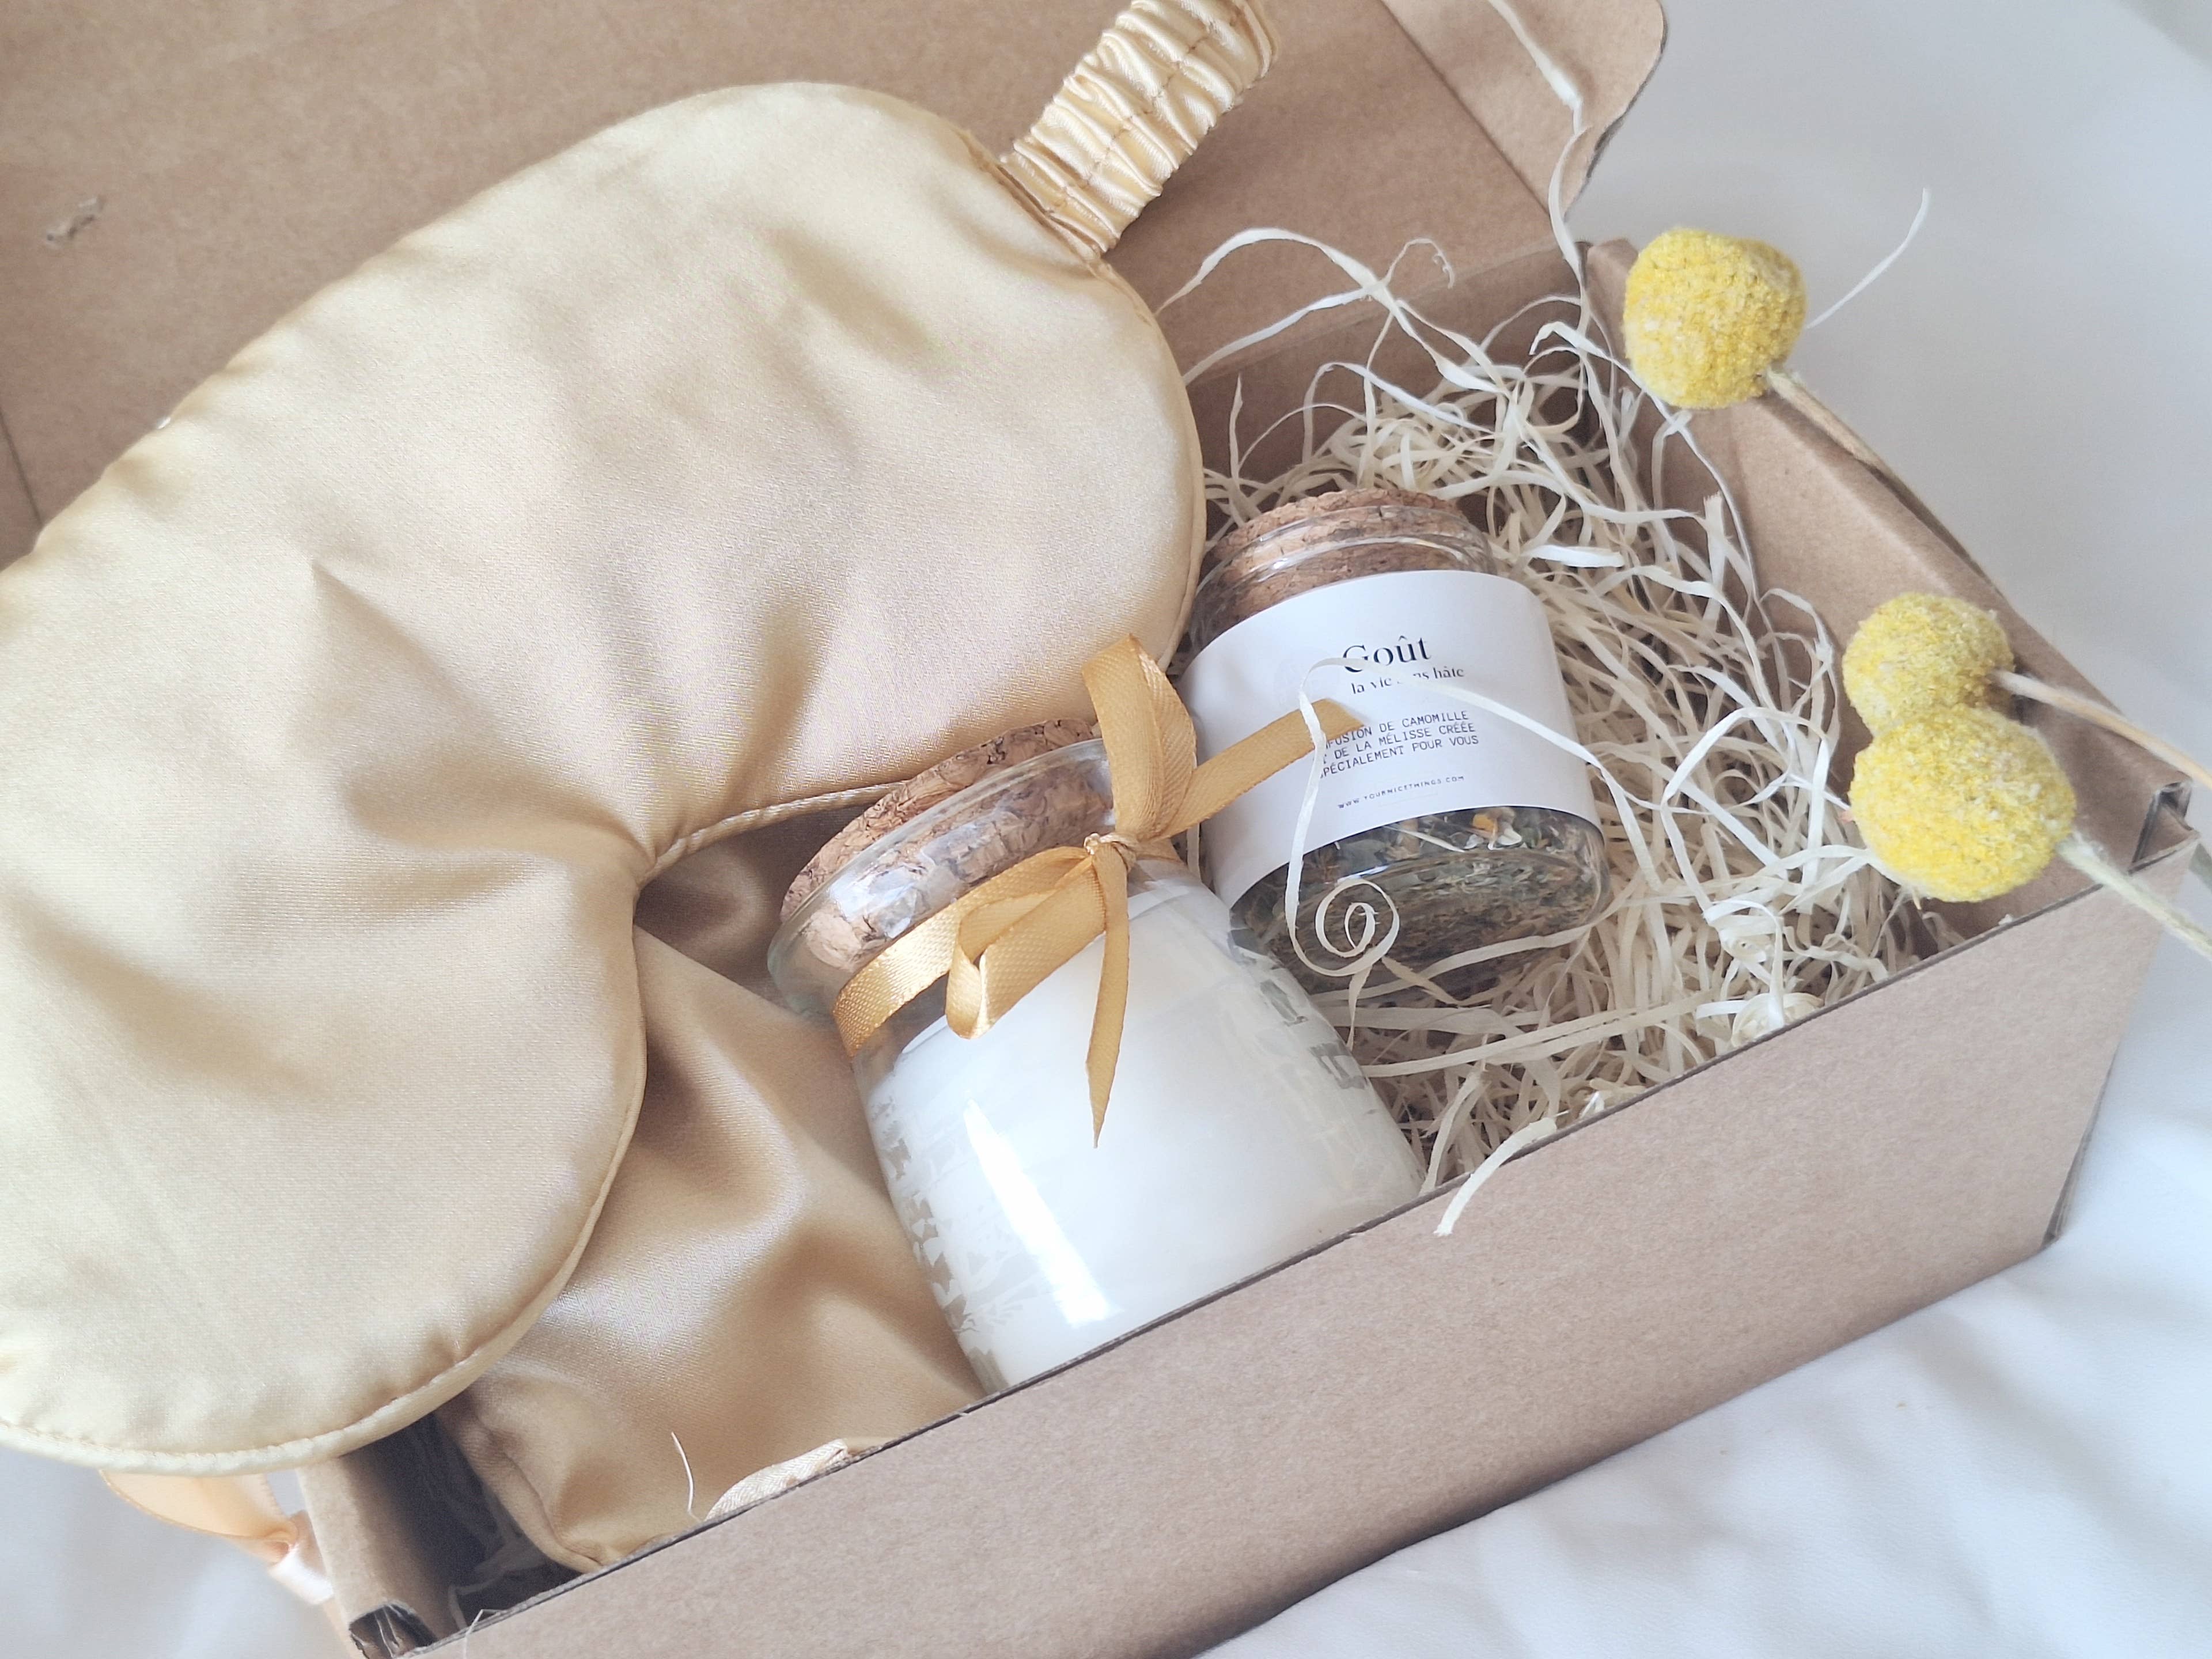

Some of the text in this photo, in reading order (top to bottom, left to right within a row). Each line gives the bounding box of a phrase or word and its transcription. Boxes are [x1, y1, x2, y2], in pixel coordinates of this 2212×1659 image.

[1343, 635, 1431, 673] Goût
[1351, 683, 1365, 695] la
[1326, 710, 1469, 749] FUSION DE CAMOMILLE
[1334, 747, 1349, 759] DE
[1356, 741, 1372, 752] LA
[1378, 727, 1432, 746] MÉLISSE
[1438, 721, 1476, 735] CRÉÉE
[1412, 739, 1443, 752] POUR
[1449, 735, 1479, 746] VOUS
